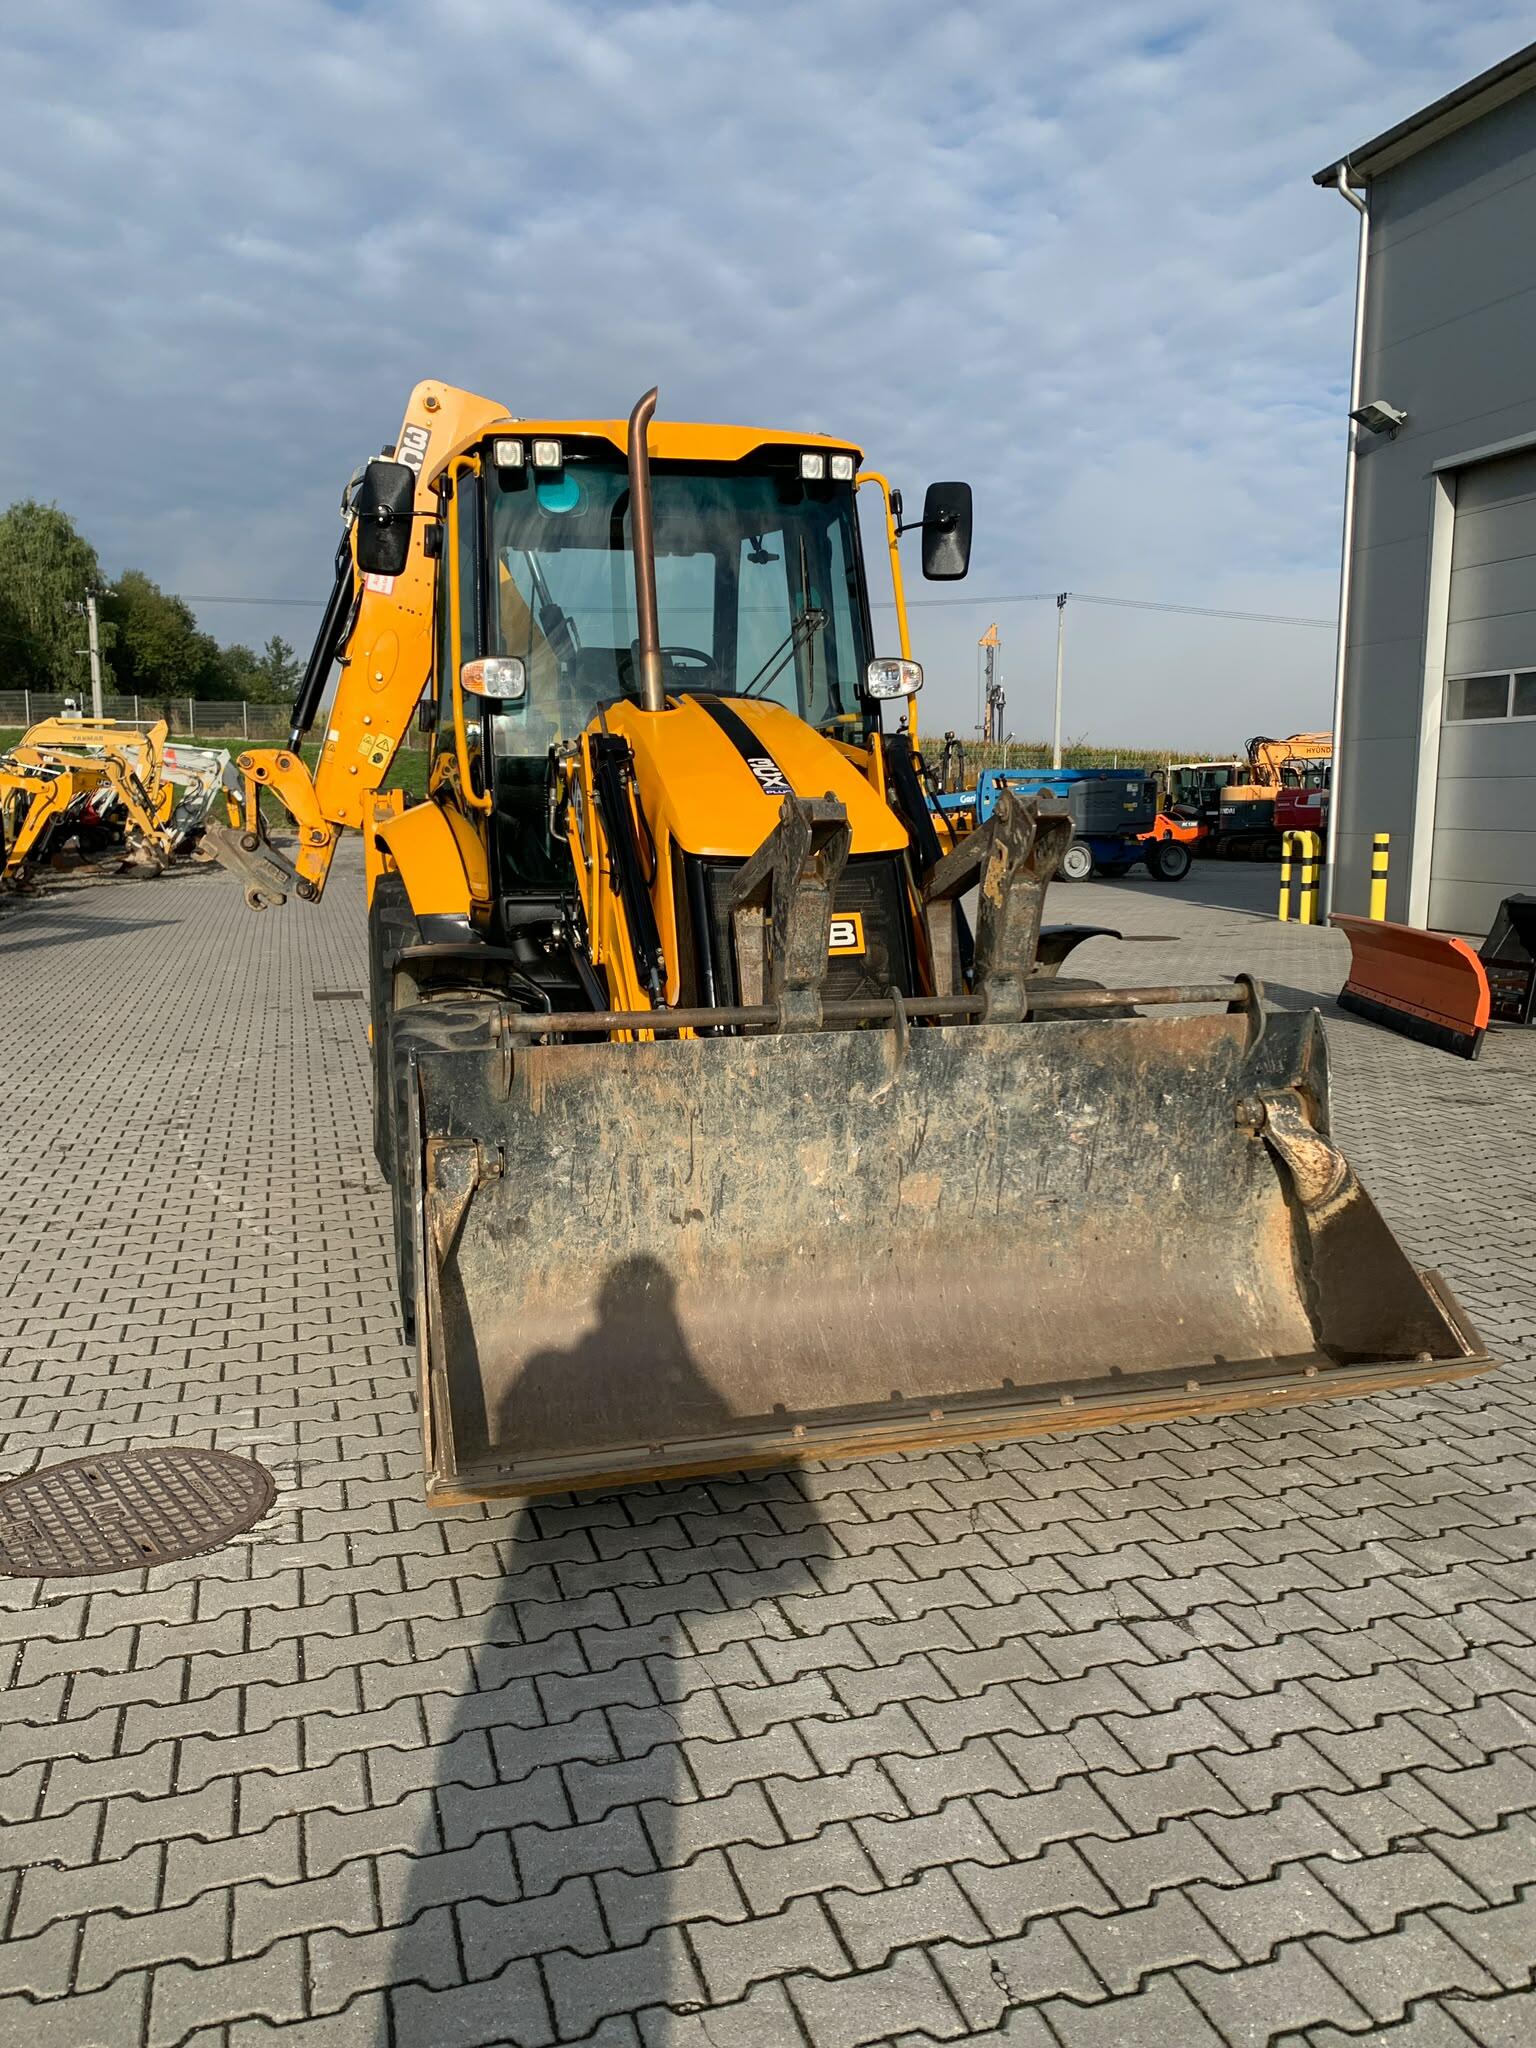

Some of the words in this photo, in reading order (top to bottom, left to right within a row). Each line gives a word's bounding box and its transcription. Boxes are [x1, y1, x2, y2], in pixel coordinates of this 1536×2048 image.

[397, 426, 429, 476] 3C
[1306, 746, 1332, 754] HYUND
[747, 758, 790, 787] 3CX
[960, 794, 977, 804] Geni
